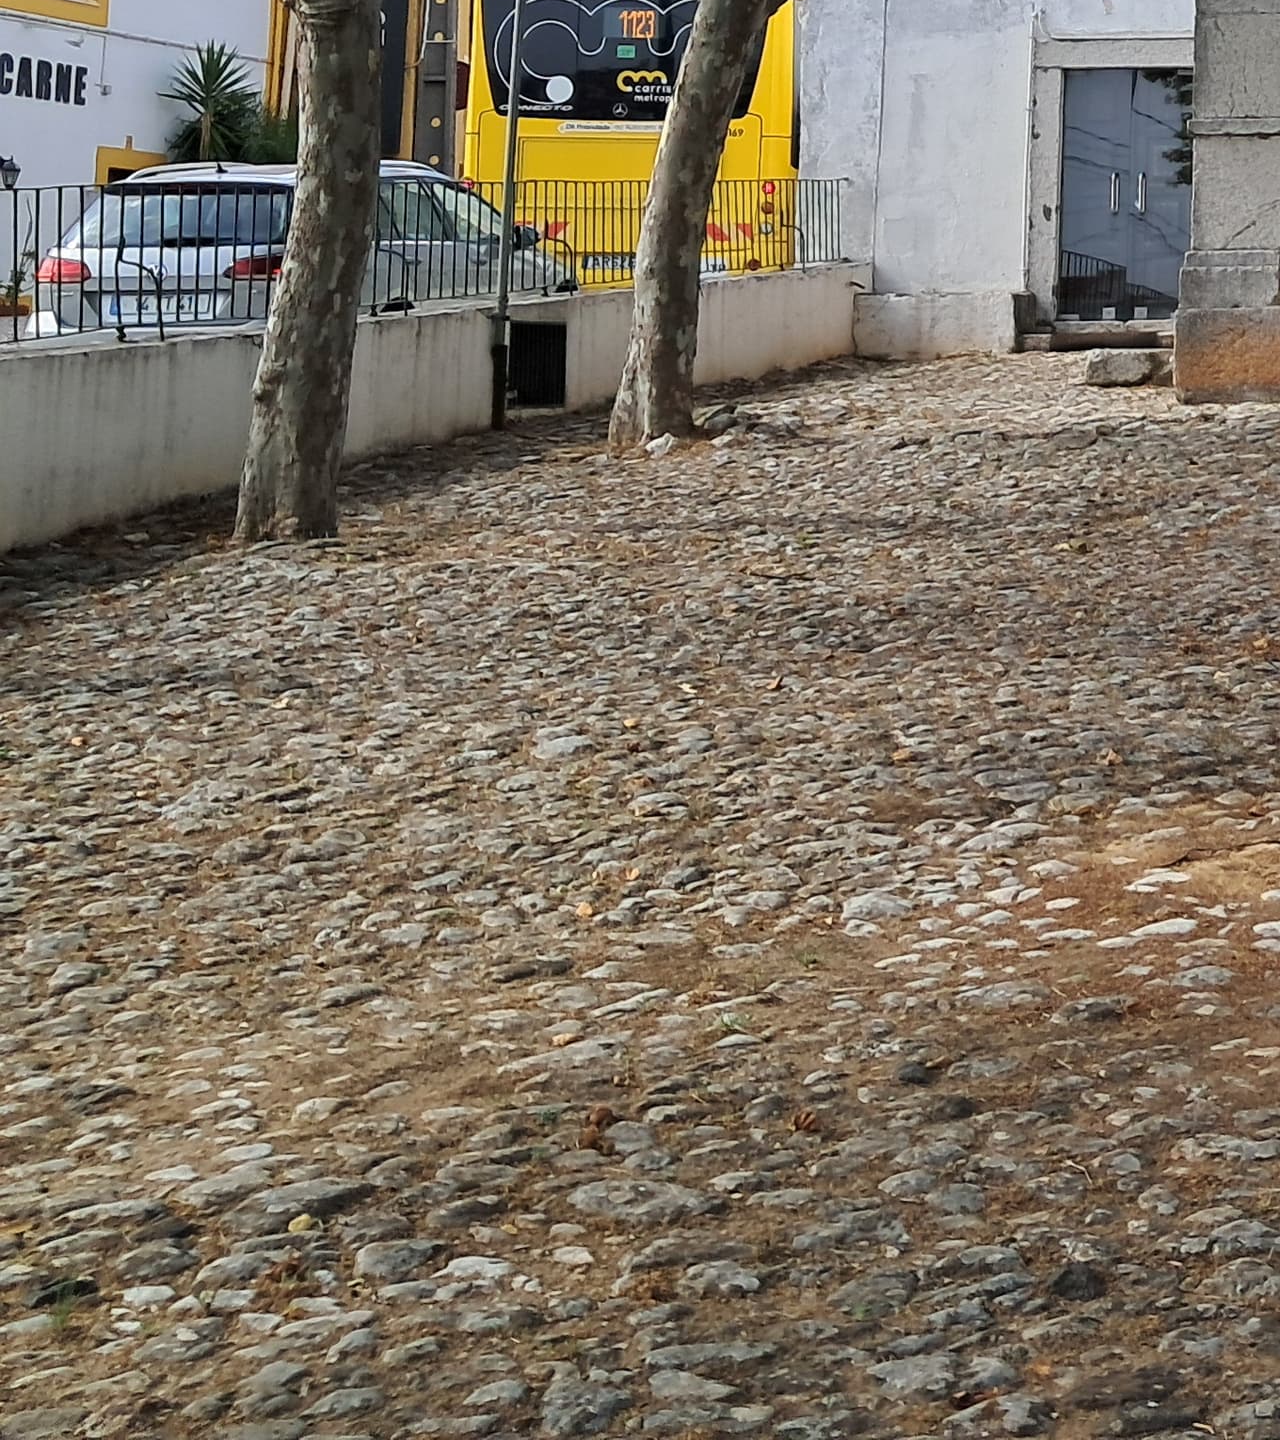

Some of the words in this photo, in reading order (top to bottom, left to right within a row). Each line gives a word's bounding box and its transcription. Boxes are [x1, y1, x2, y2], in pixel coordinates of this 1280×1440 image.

[619, 10, 655, 39] 1123
[0, 53, 88, 106] CARNE
[498, 104, 574, 112] CNECTO
